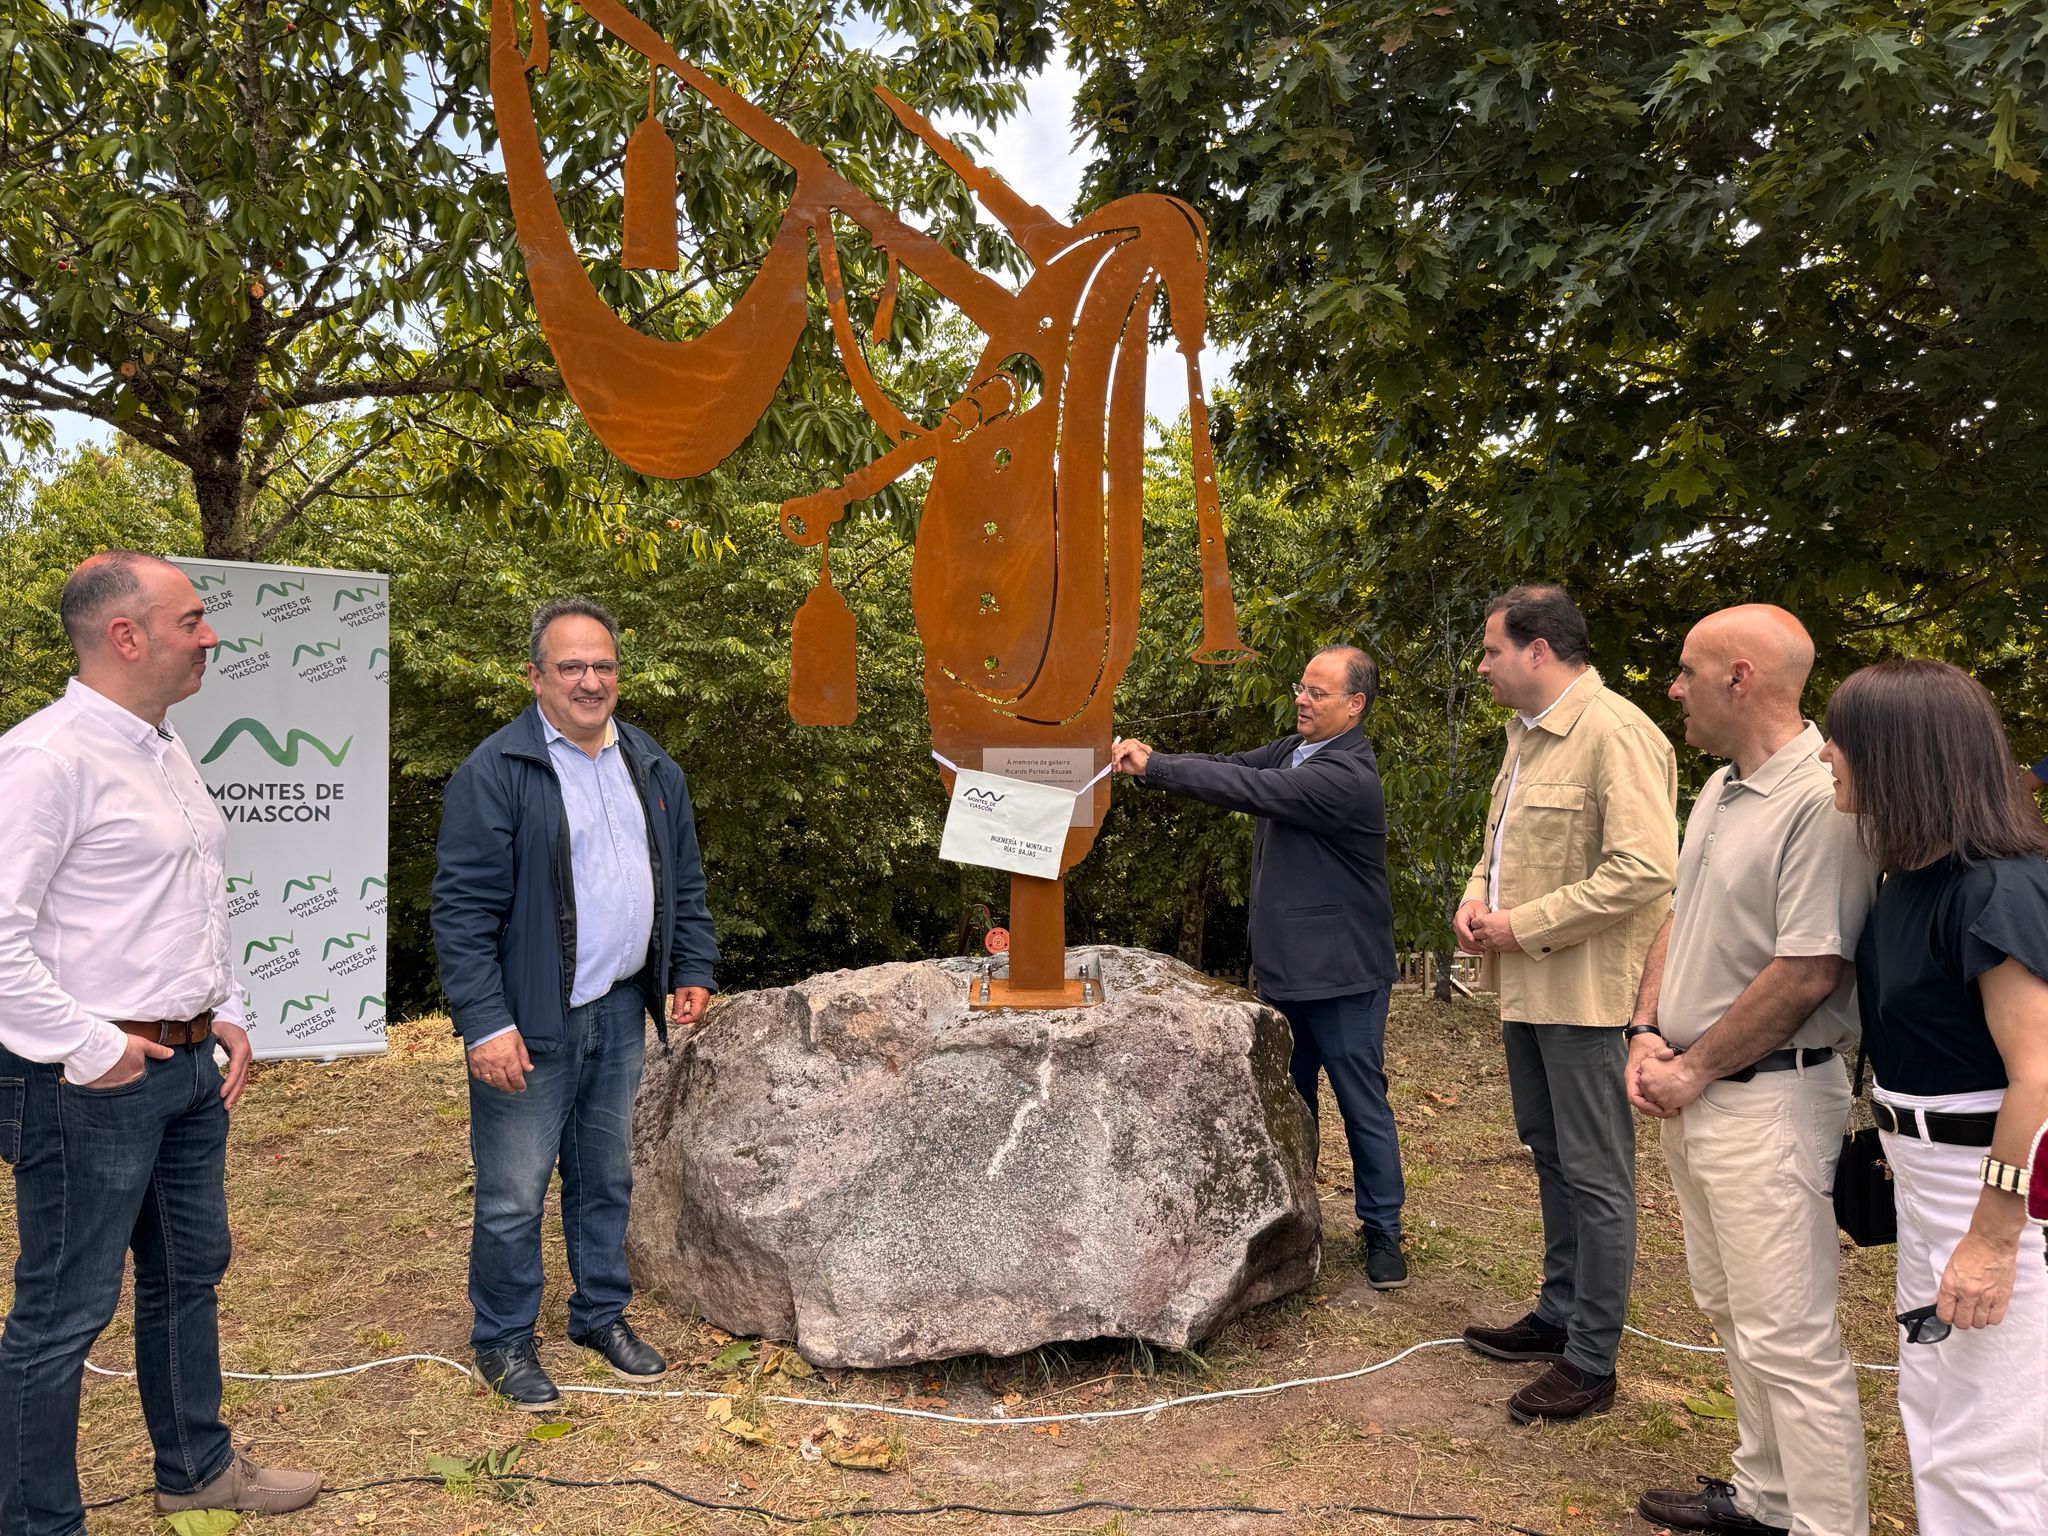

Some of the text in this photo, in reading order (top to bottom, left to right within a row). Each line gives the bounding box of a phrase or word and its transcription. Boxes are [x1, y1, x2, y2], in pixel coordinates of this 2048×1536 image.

[220, 589, 233, 600] DE
[261, 595, 312, 618] MONTES DE
[338, 601, 387, 623] MONTES DE
[219, 651, 271, 676] MONTES DE
[298, 655, 348, 679] MONTES DE
[1048, 759, 1070, 767] gaiteiro
[206, 783, 344, 800] MONTES DE
[968, 796, 988, 805] MONTES
[222, 801, 330, 822] VIASCÓN
[1018, 848, 1037, 858] BAJAS
[1026, 842, 1053, 853] MONTAJES
[247, 889, 261, 900] DE
[288, 887, 339, 914] MONTES DE
[249, 948, 301, 976] MONTES DE
[328, 944, 378, 973] MONTES DE
[245, 1011, 258, 1022] DE
[286, 1006, 337, 1036] MONTES DE
